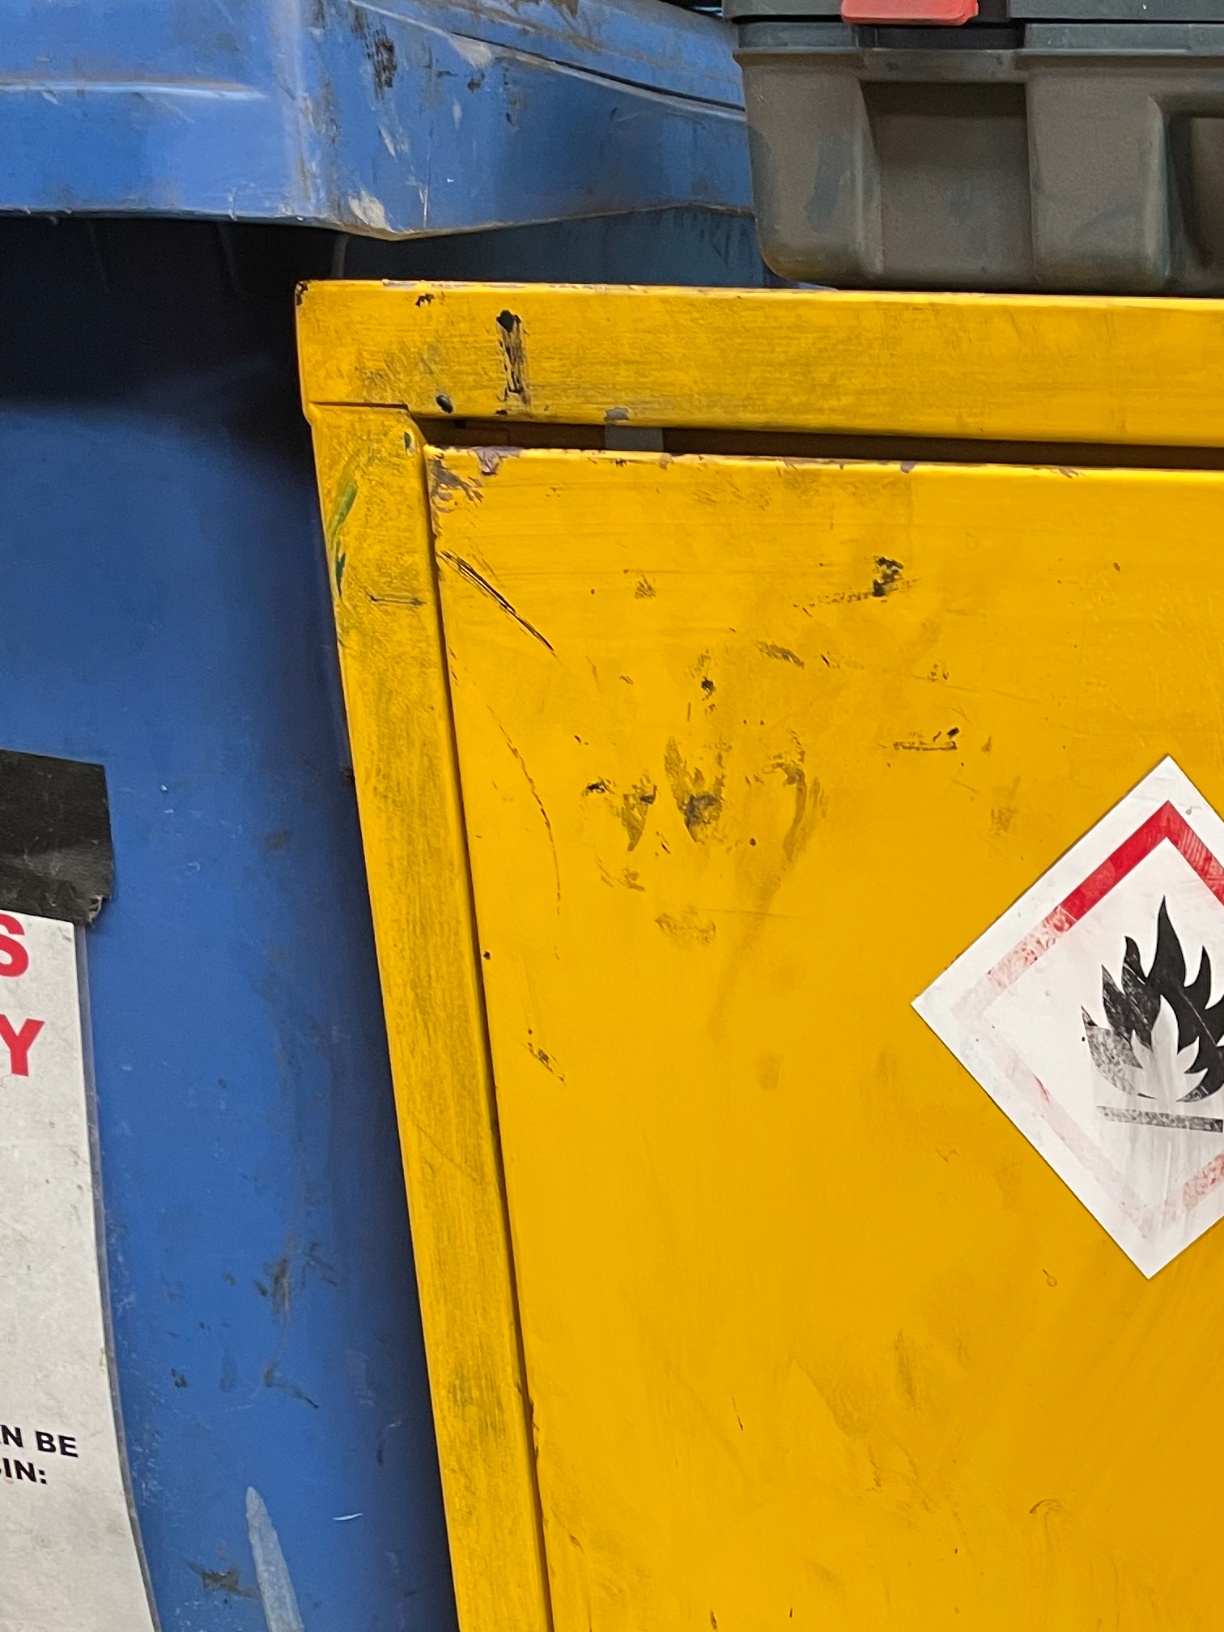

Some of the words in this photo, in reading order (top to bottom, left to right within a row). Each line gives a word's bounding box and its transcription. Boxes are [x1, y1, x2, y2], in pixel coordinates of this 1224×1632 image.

[0, 1424, 23, 1448] N
[35, 1430, 78, 1457] BE
[0, 1457, 47, 1485] IN:
